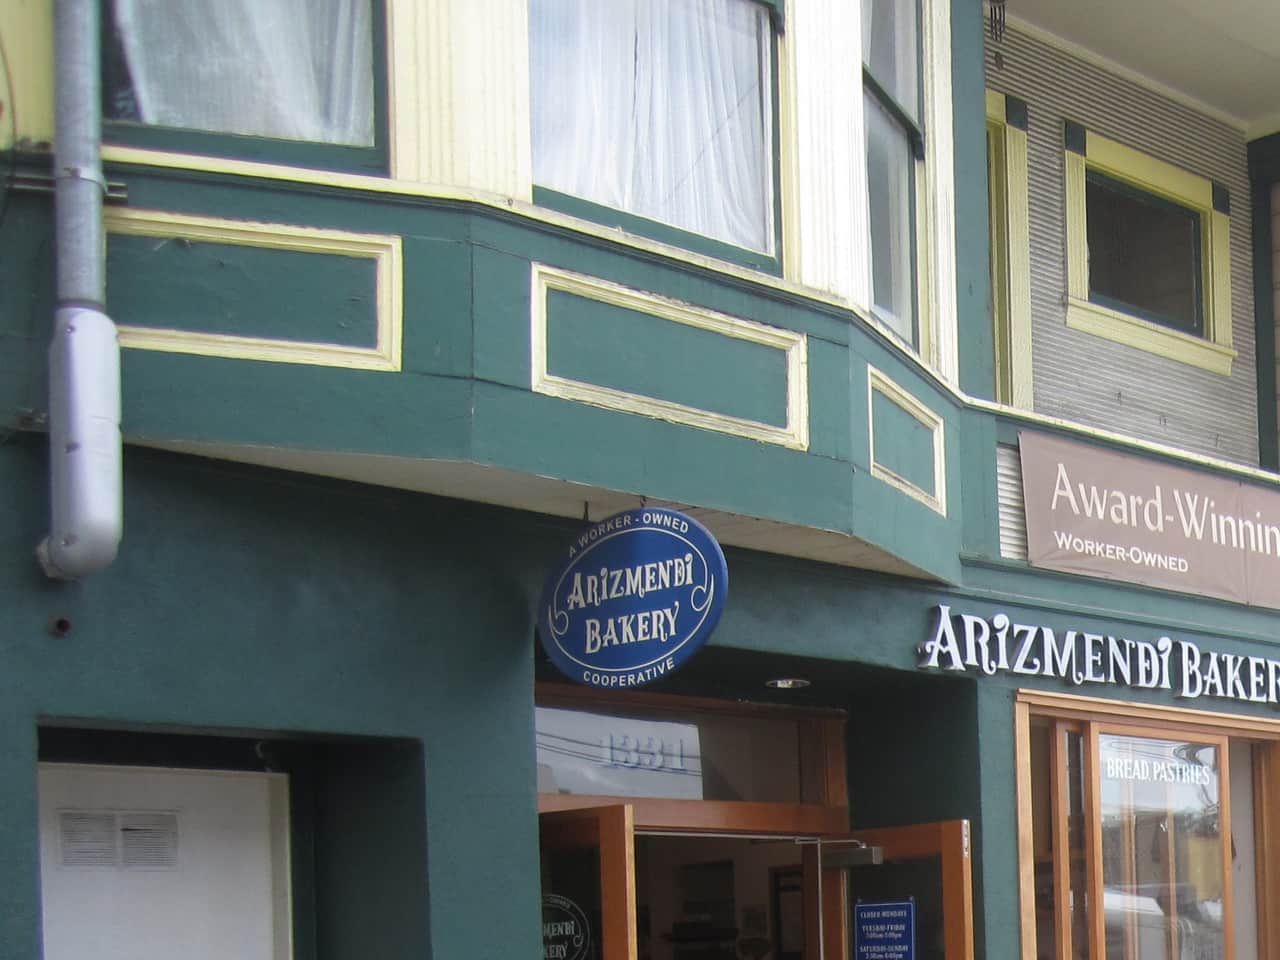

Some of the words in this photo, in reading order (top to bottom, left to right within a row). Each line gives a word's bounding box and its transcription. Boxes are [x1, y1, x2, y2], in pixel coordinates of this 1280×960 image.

[569, 545, 576, 558] A
[1054, 530, 1189, 573] WORKER-OWNED
[567, 553, 694, 611] ARIZMENDI
[586, 601, 680, 655] BAKERY
[924, 604, 1172, 690] ARIZMENDI
[584, 657, 675, 687] COOPERATIVE
[1153, 761, 1210, 785] PASTRIES
